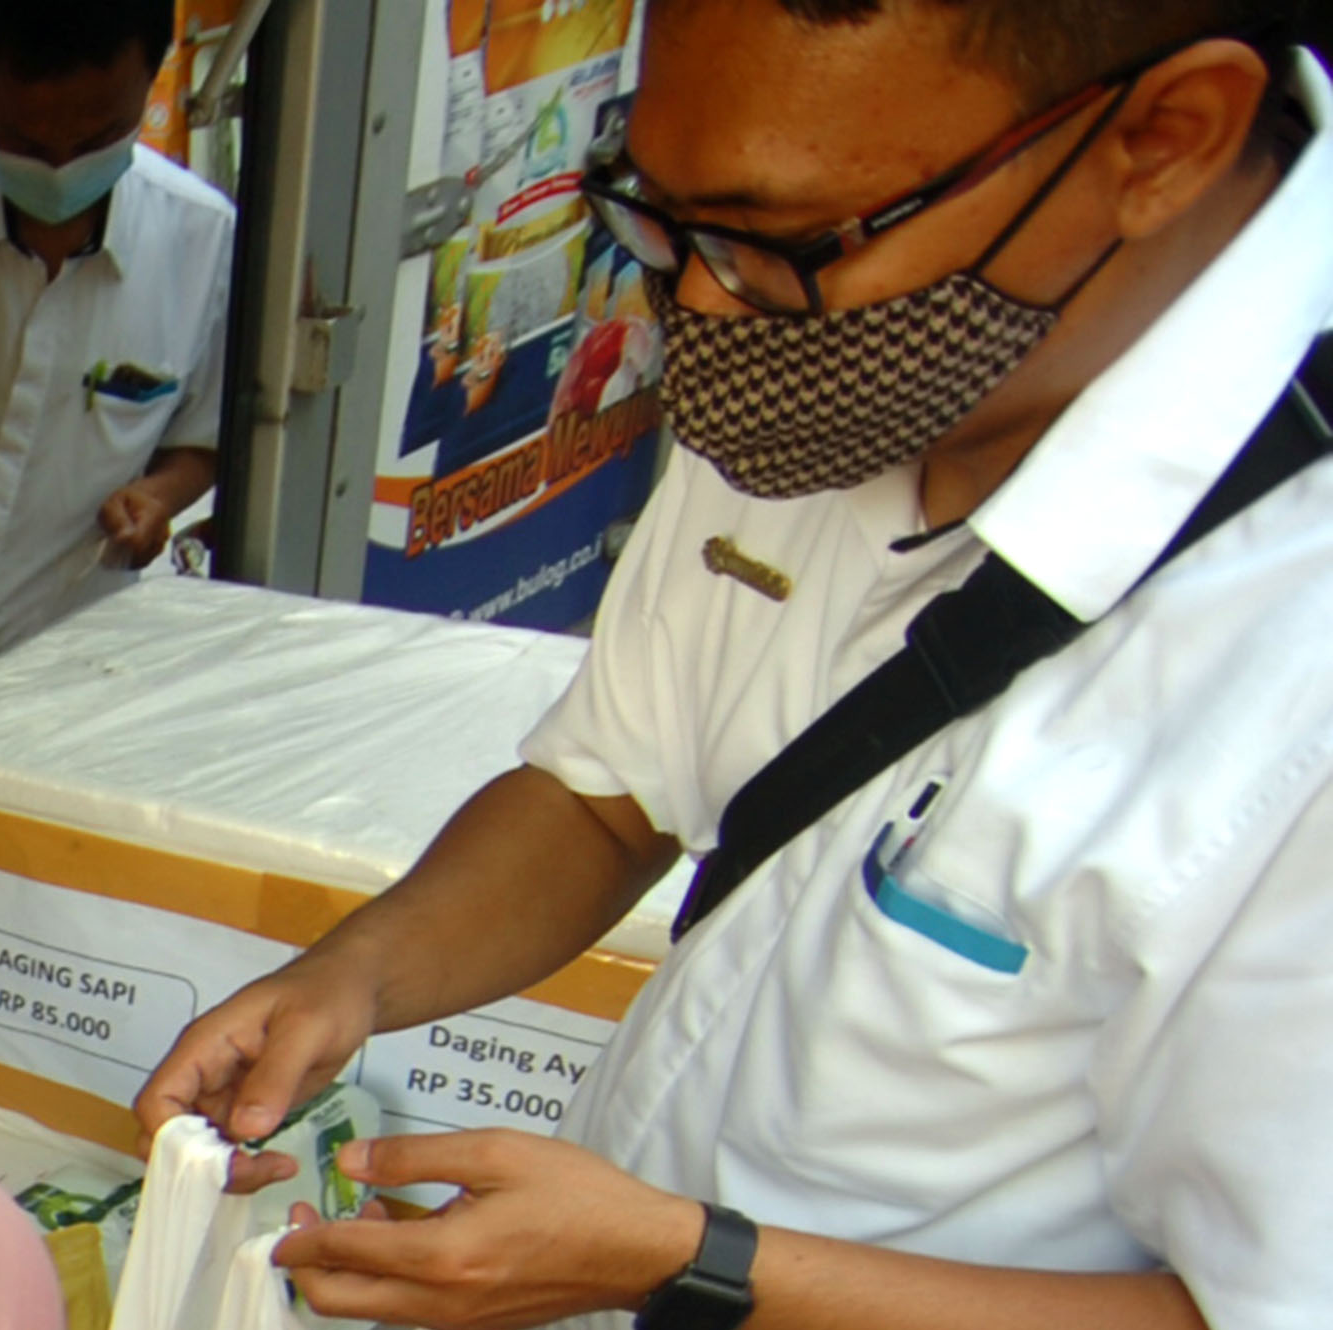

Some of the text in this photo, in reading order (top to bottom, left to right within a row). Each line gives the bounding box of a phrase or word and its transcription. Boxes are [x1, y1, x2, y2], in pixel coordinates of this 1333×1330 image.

[79, 973, 137, 1005] SAPI
[31, 1000, 111, 1041] 85.000
[429, 1025, 586, 1086] Daging Ay
[407, 1067, 564, 1122] RP 35.000
